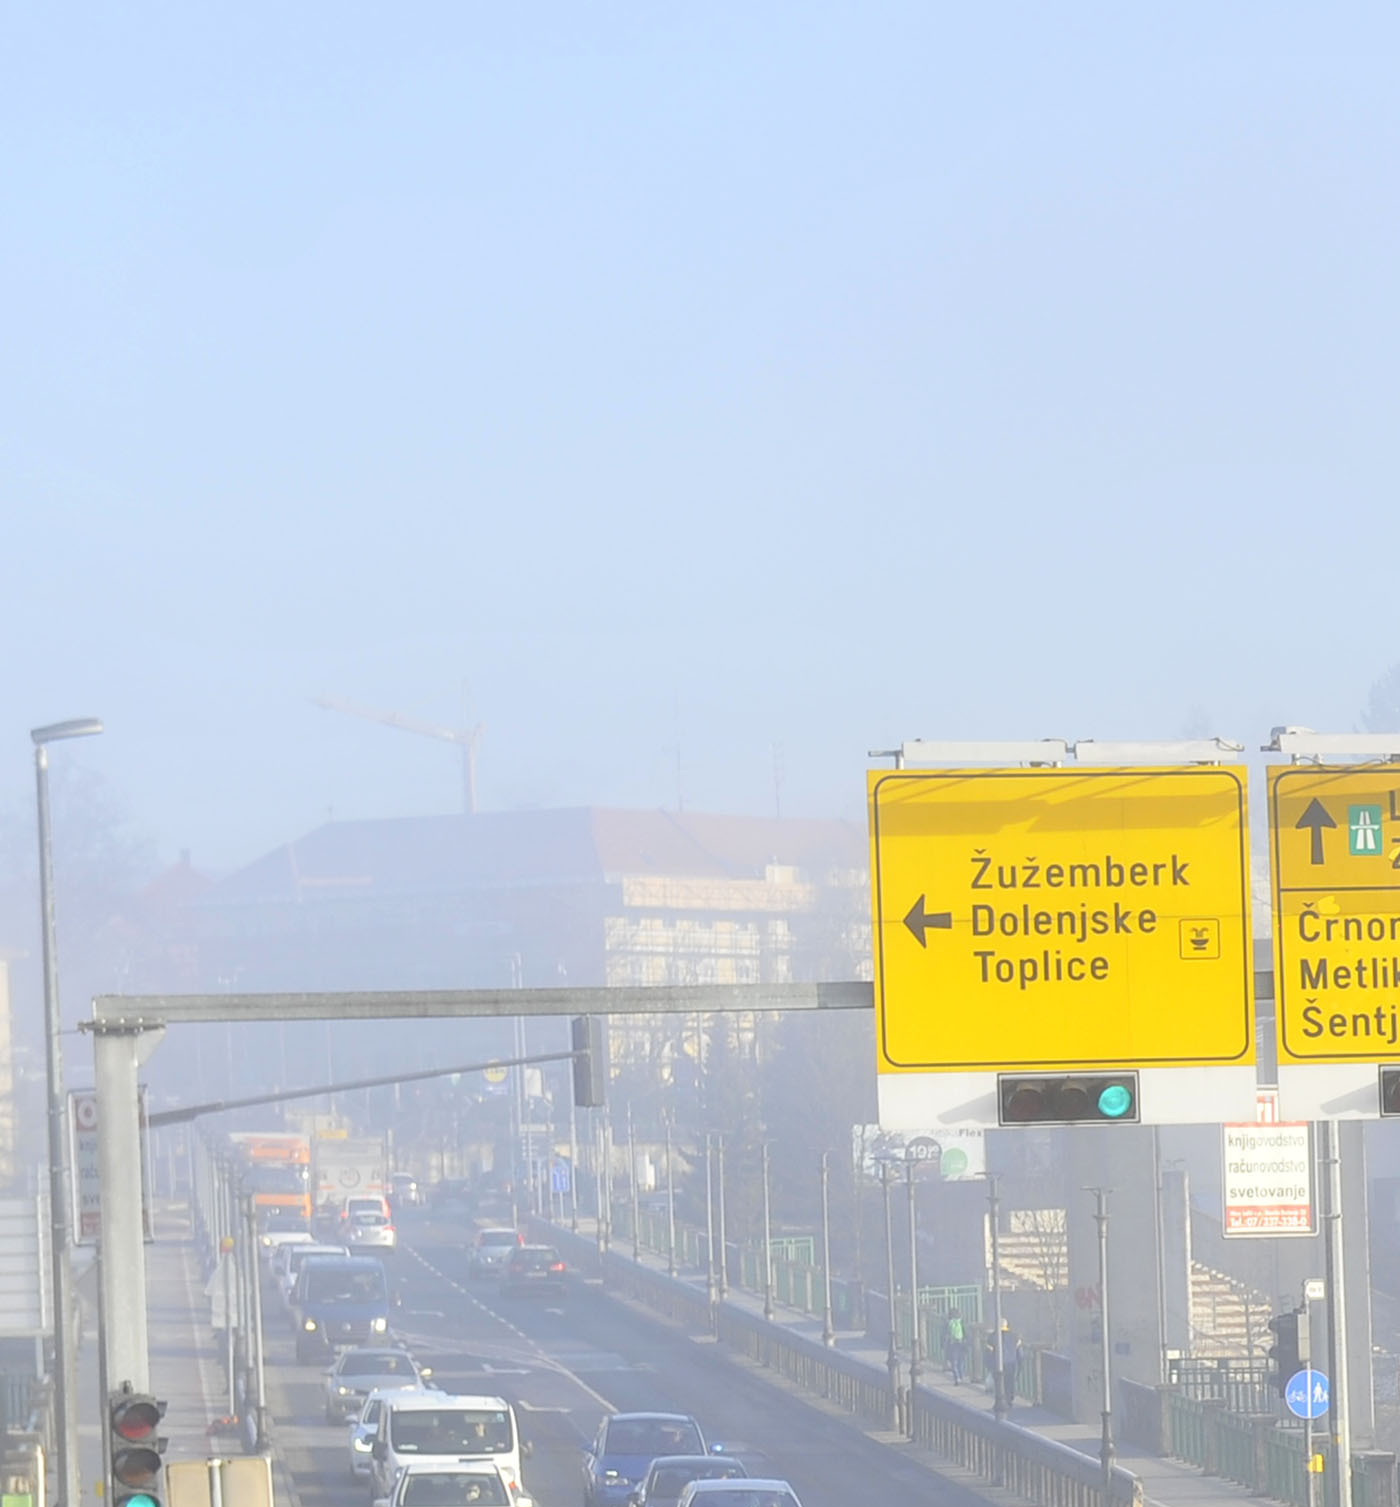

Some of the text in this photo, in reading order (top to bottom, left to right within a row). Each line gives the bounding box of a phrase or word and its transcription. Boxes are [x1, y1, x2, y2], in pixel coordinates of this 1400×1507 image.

[970, 849, 1189, 889] Žužemberk
[972, 903, 1157, 942] Dolenjske
[973, 951, 1109, 990] Toplice
[1228, 1135, 1305, 1150] knjigovodstvo
[1229, 1158, 1305, 1173] računovodstvo
[1230, 1186, 1306, 1200] svetovanje
